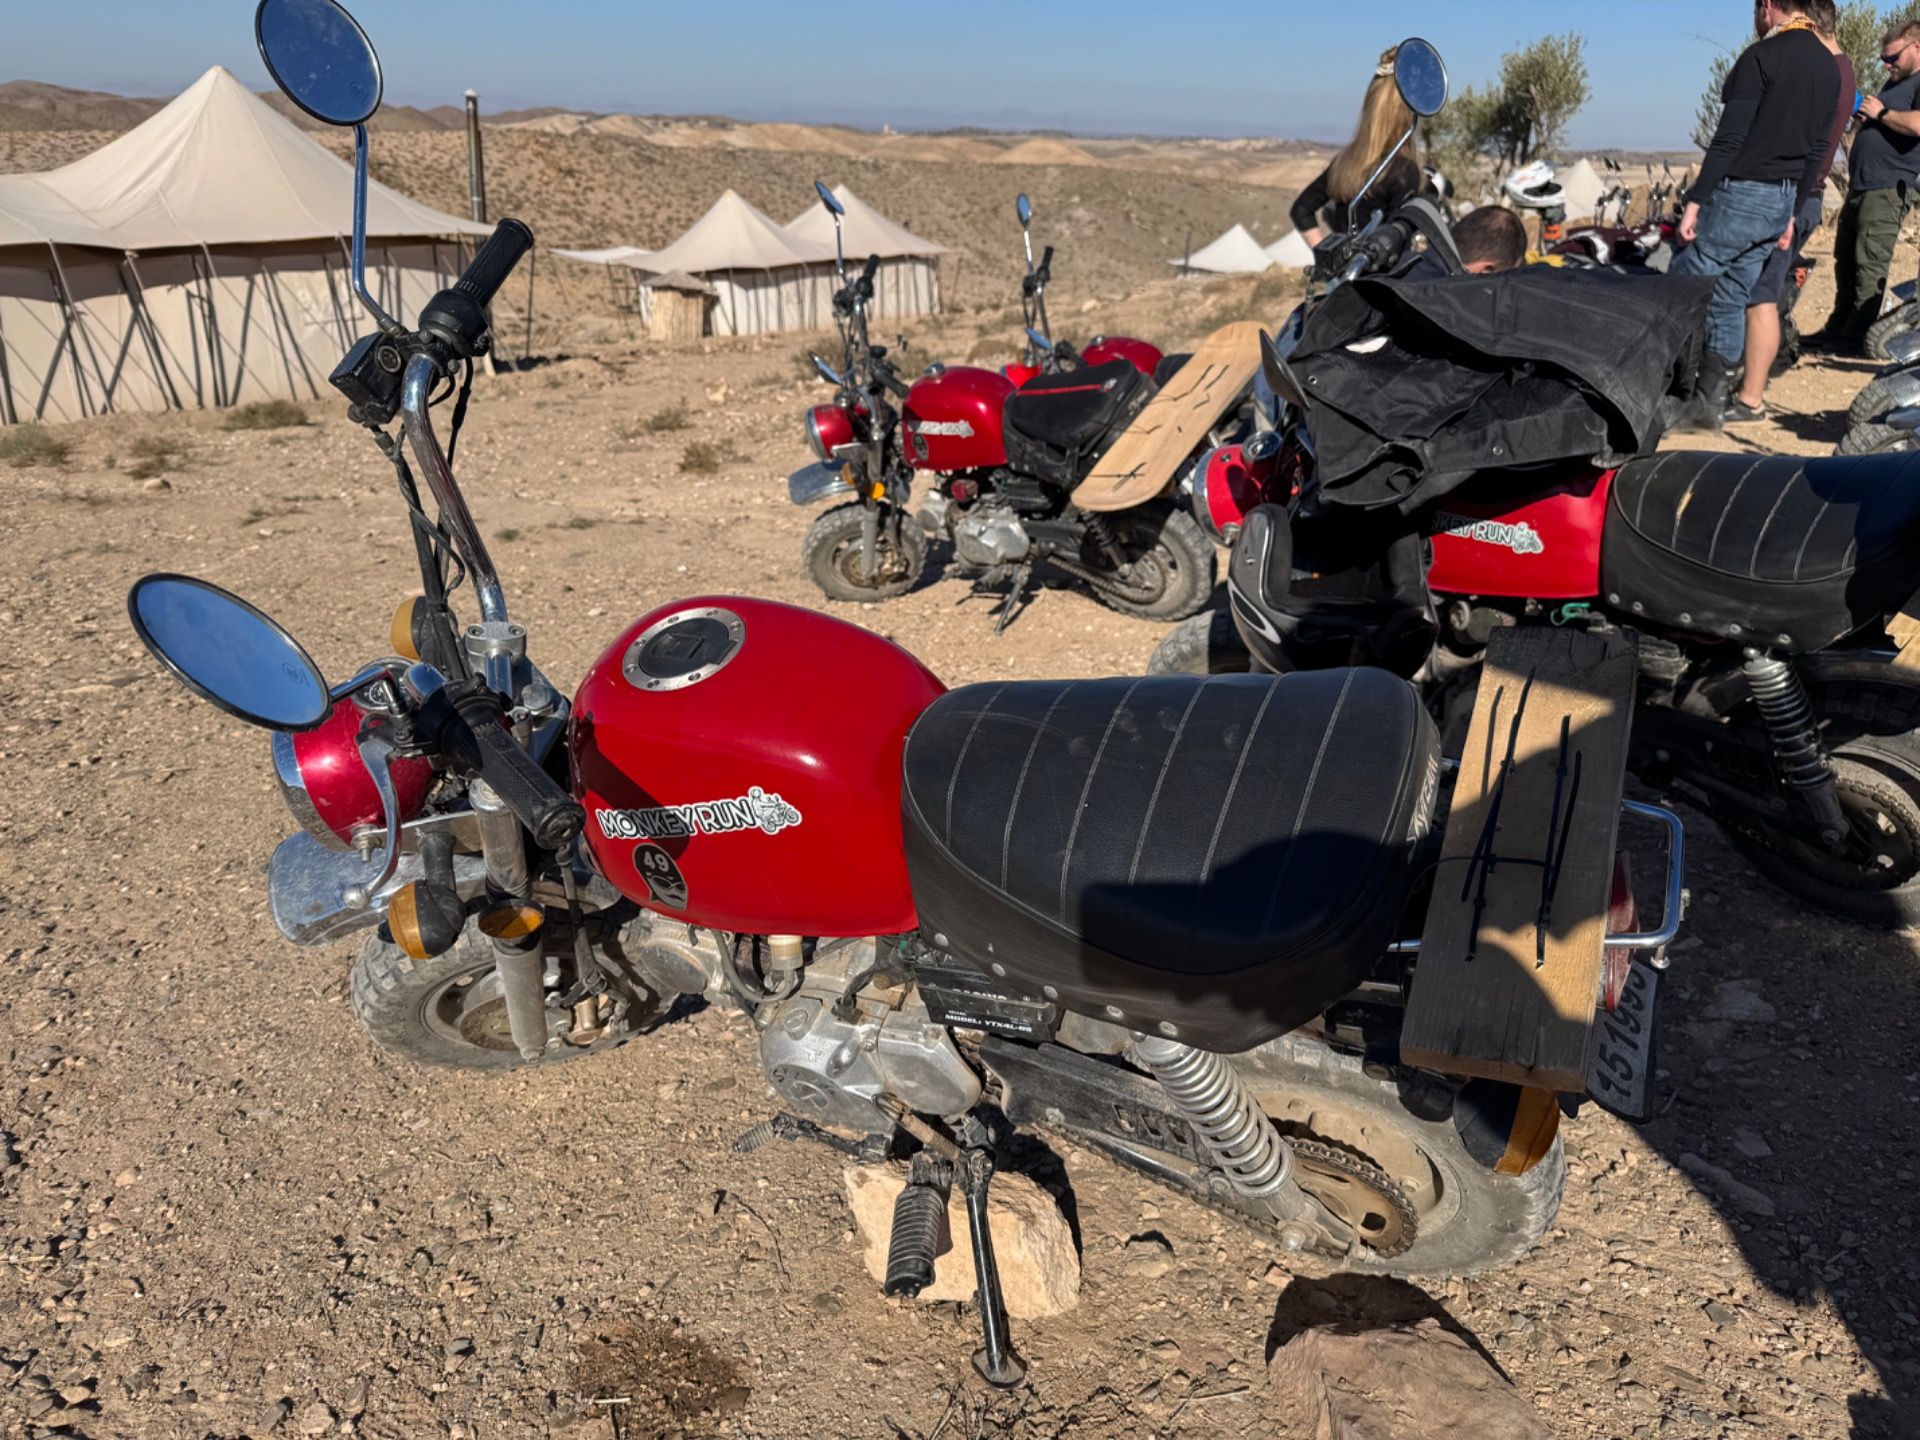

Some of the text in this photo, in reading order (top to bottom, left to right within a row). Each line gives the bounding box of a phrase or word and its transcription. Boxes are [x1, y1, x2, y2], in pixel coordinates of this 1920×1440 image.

[1474, 521, 1514, 545] RUN
[597, 798, 757, 838] MONKEY RUN
[644, 852, 670, 873] 49
[945, 1014, 982, 1025] MODEL:
